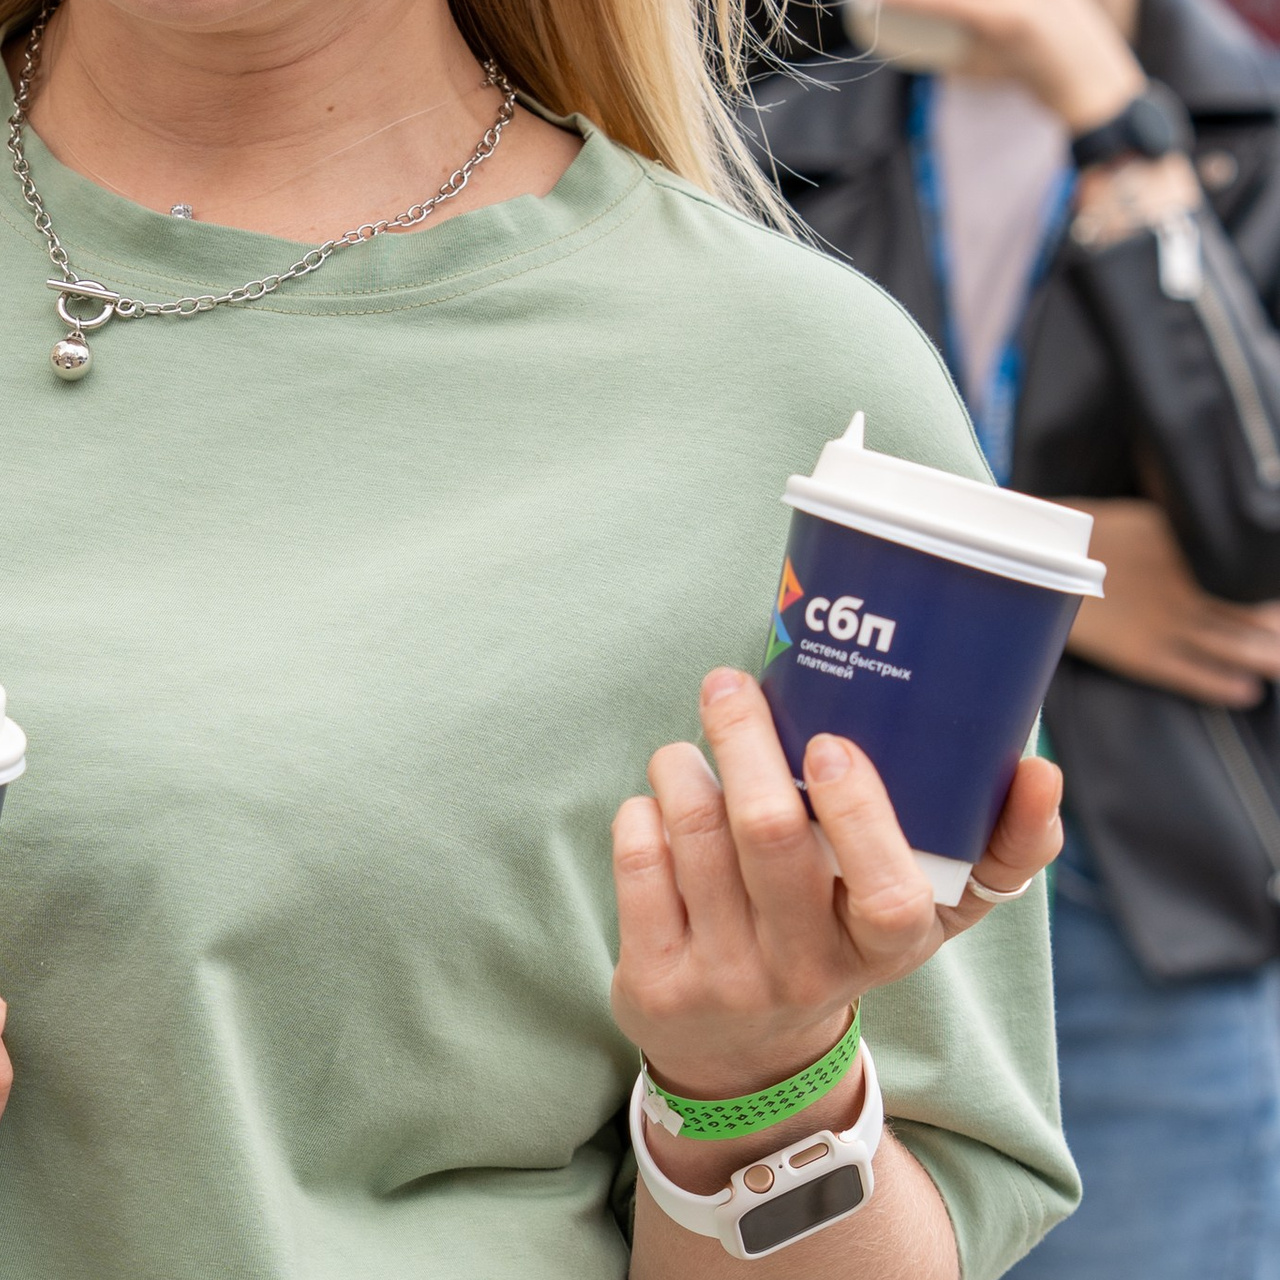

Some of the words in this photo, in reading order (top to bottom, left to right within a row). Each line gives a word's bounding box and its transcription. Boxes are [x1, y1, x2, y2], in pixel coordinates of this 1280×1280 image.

[805, 595, 896, 653] сбп
[797, 653, 854, 680] платежей
[800, 638, 848, 662] система
[849, 651, 912, 681] быстрых
